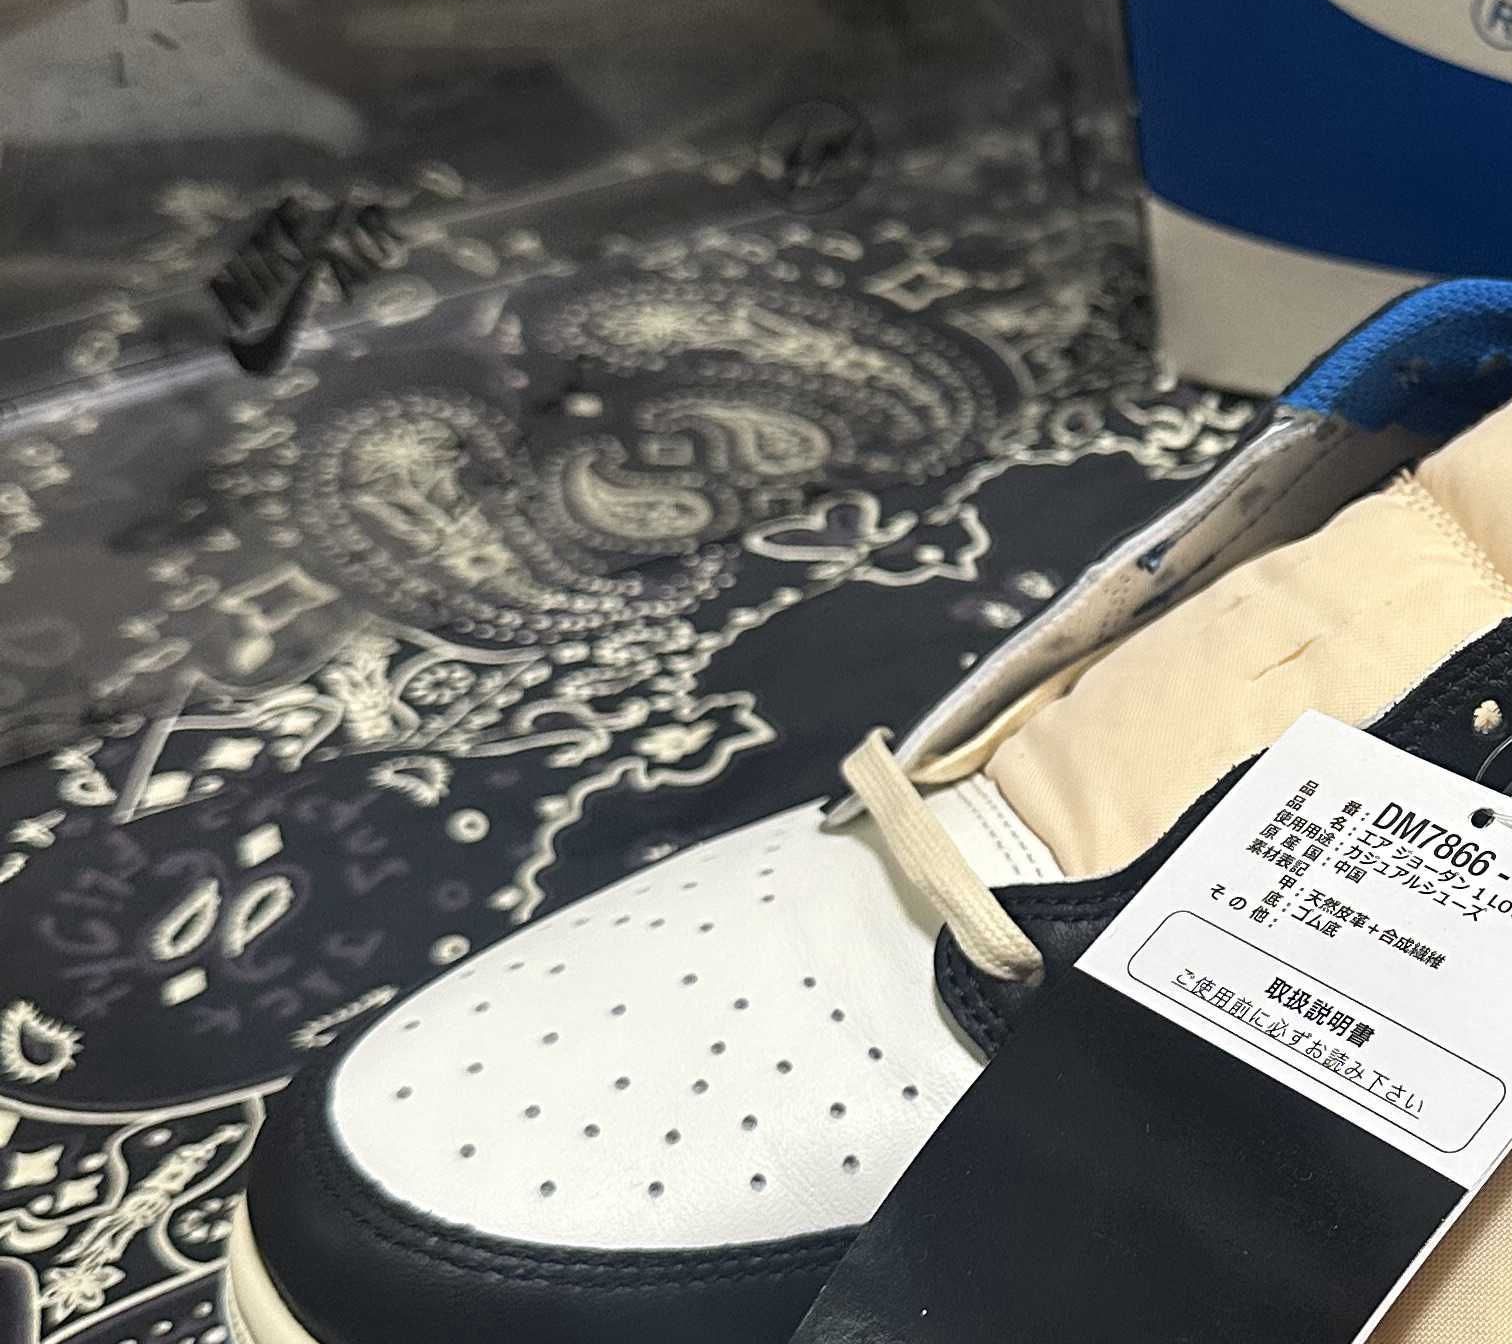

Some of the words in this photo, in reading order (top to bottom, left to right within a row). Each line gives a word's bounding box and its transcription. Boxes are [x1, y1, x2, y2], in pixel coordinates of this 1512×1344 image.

[1372, 801, 1497, 877] DM7866
[1174, 966, 1424, 1114] ご使用前に必ずお読み下さい
[1265, 976, 1376, 1048] 取扱説明書
